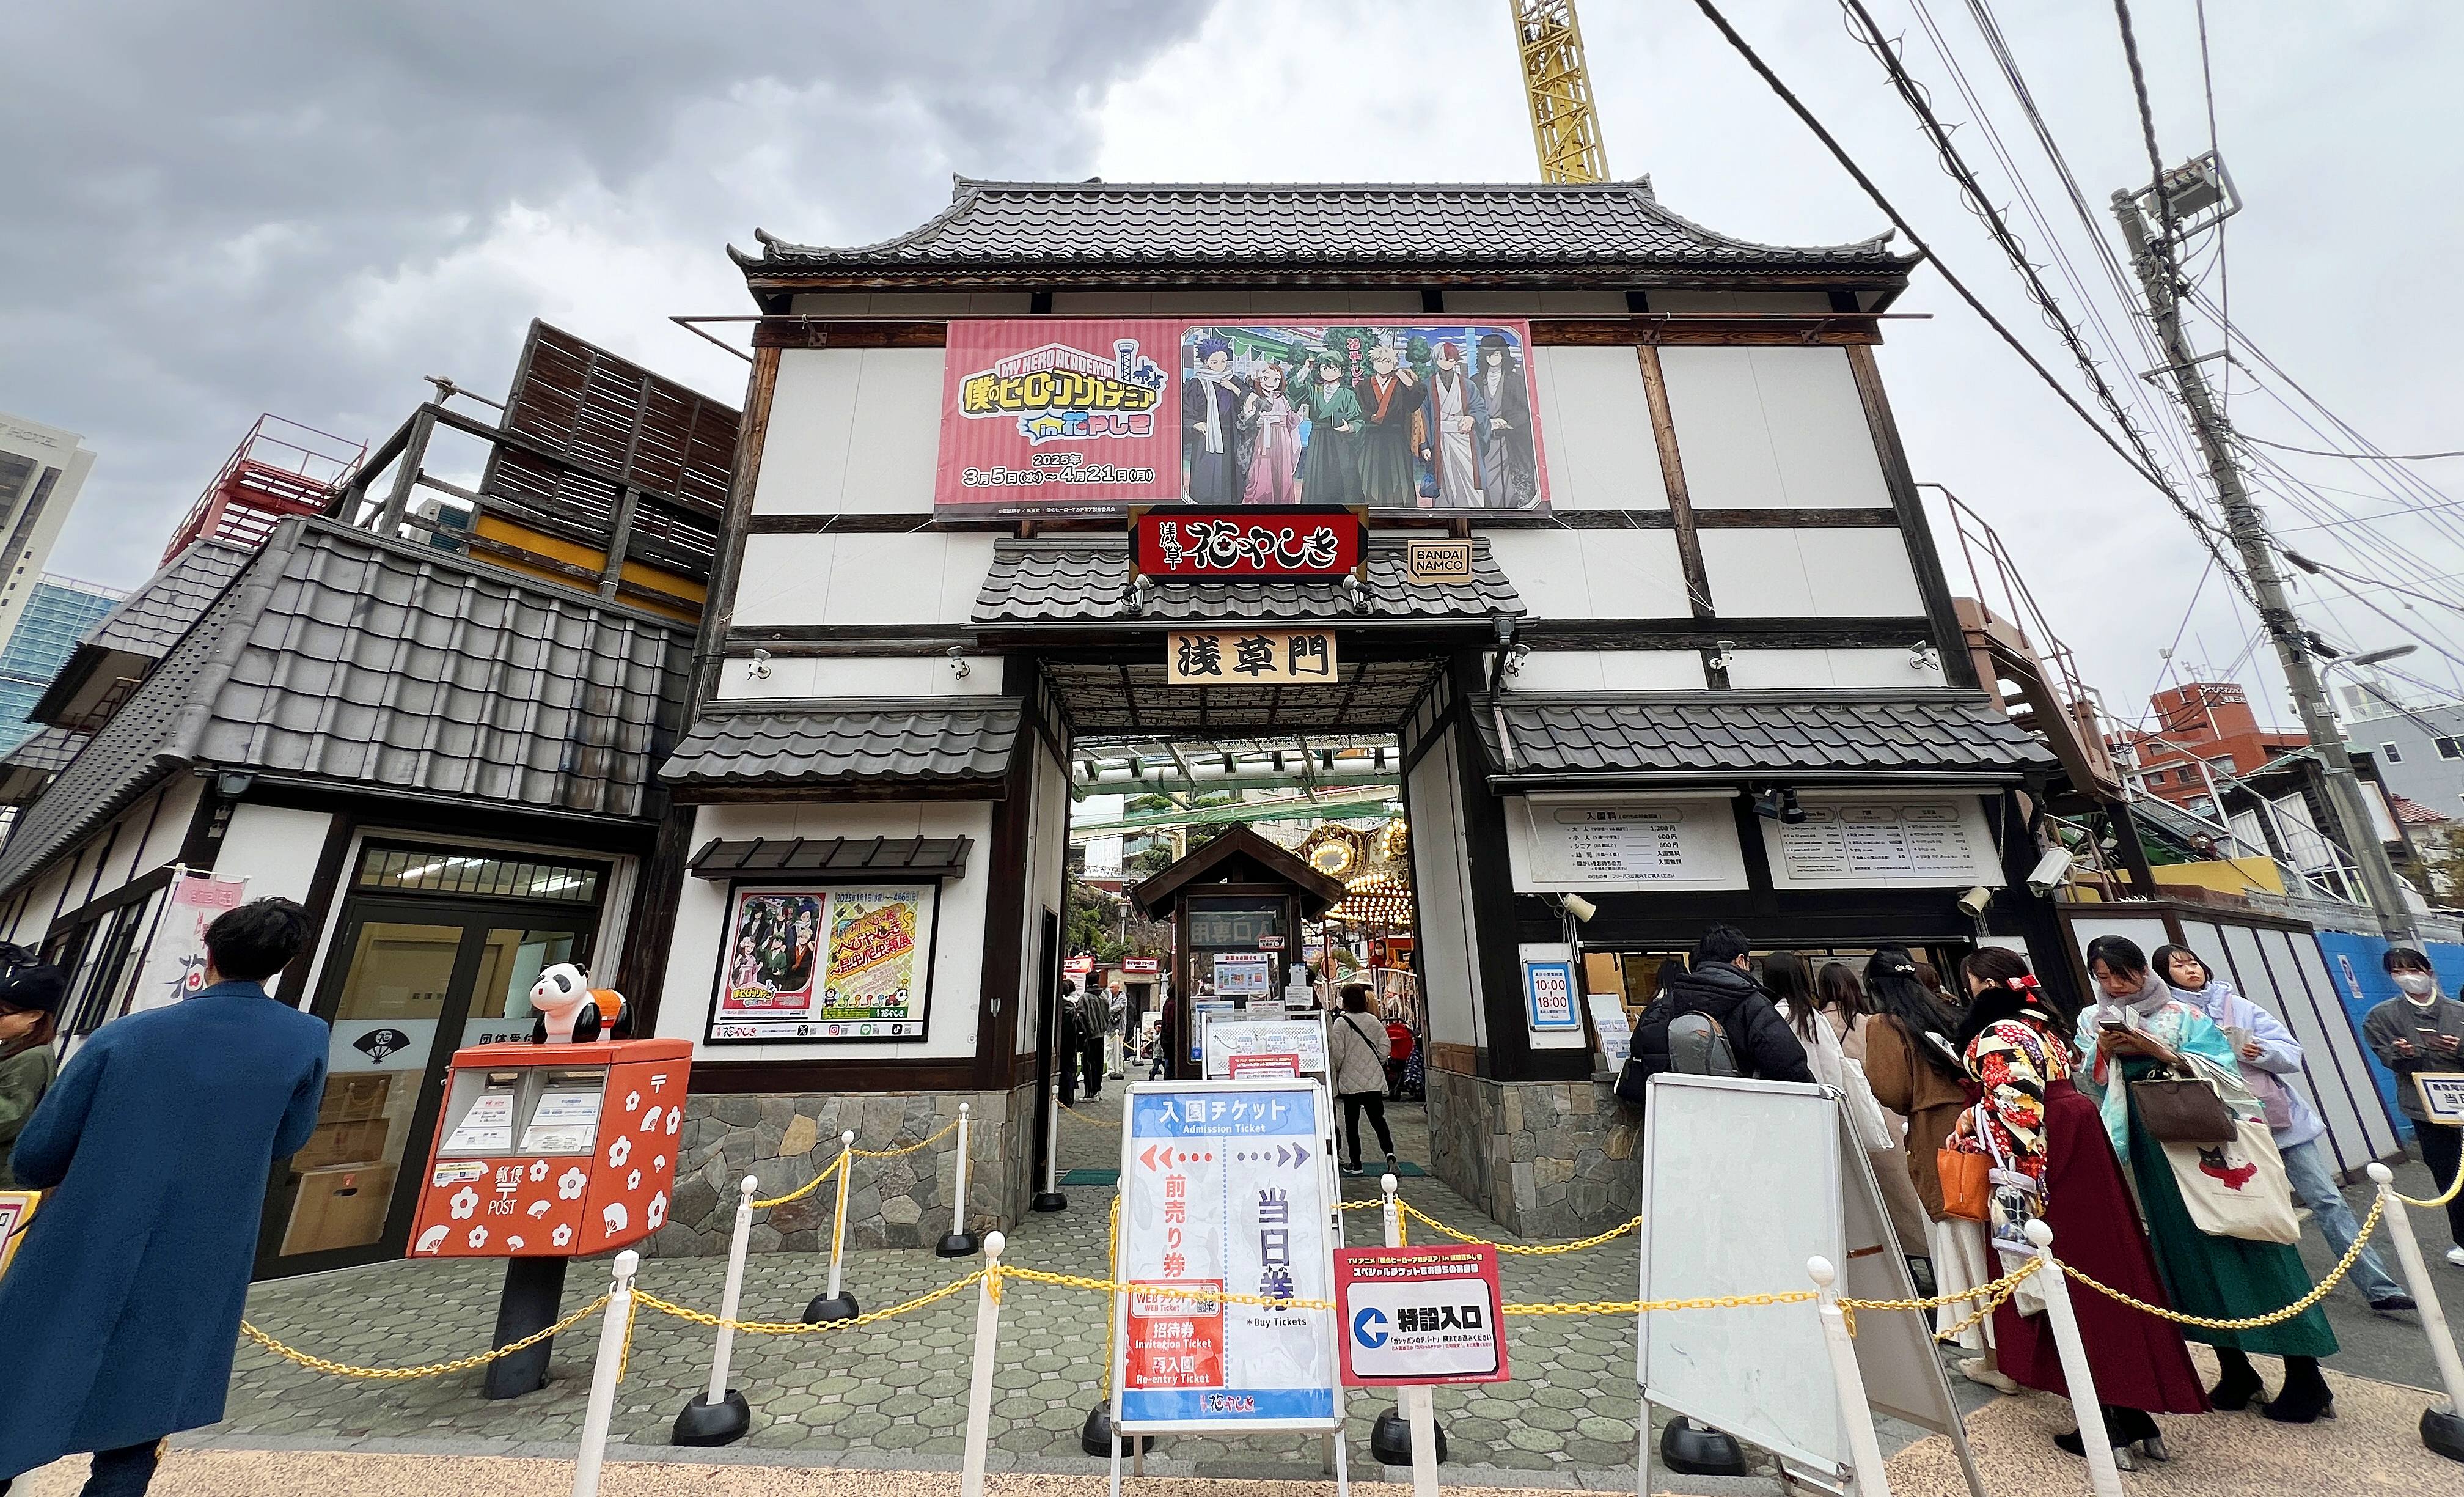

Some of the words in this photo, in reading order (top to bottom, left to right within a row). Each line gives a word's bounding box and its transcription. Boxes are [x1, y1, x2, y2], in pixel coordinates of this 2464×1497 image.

[1002, 361, 1021, 378] MY
[1023, 349, 1054, 373] HERO
[1057, 350, 1115, 378] ACADEMIA
[1040, 424, 1058, 437] in
[1062, 412, 1151, 436] 花やしき
[1033, 454, 1082, 466] 2025年
[1159, 521, 1183, 570] 浅草
[1182, 519, 1338, 570] 花やしき
[1417, 550, 1464, 559] BANDAI
[1417, 561, 1464, 570] NAMCO
[1177, 634, 1329, 677] 浅草門
[1535, 979, 1566, 991] 10:00
[1538, 996, 1567, 1008] 18:00
[1159, 1099, 1285, 1125] 入園チケット
[1183, 1124, 1233, 1135] Admission
[1235, 1124, 1266, 1133] Ticket
[495, 1165, 524, 1184] 郵便
[487, 1199, 518, 1215] POST
[1164, 1174, 1187, 1278] 前売り券
[1274, 1317, 1307, 1326] Tickets
[1397, 1305, 1483, 1333] 特設入口
[1153, 1322, 1195, 1339] 招待券
[1135, 1339, 1181, 1350] Invitation
[1184, 1339, 1212, 1349] Ticket
[1152, 1356, 1195, 1374] 再入園
[1137, 1374, 1178, 1385] Re-entry
[1181, 1374, 1209, 1384] Ticket
[1208, 1393, 1255, 1413] 花やしき
